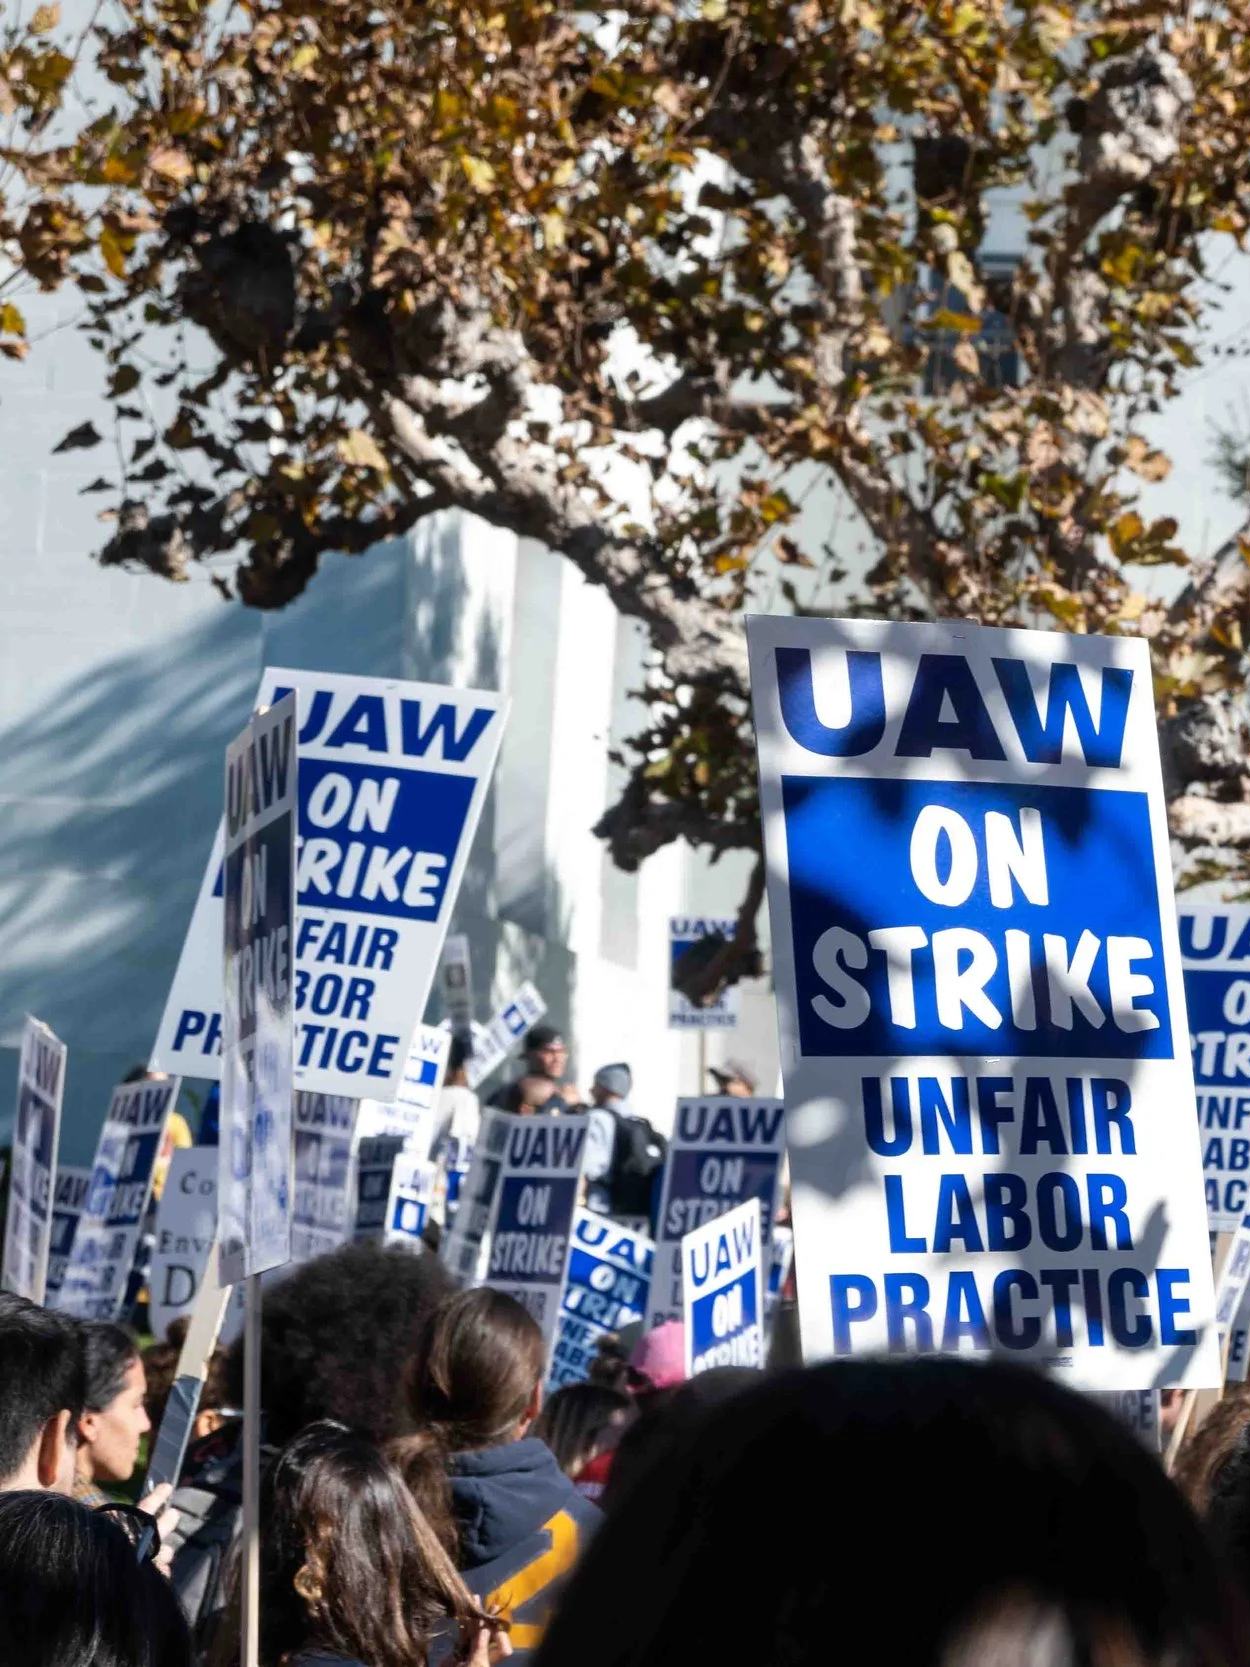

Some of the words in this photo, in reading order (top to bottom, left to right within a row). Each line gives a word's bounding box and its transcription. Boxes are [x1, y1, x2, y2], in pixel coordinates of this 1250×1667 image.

[775, 647, 1135, 769] UAW
[306, 772, 400, 833] ON
[298, 836, 447, 908] RIKE
[909, 804, 1049, 909] ON
[297, 918, 400, 971] FAIR
[810, 926, 1160, 1034] STRIKE
[508, 1124, 587, 1170] UAW
[678, 1105, 785, 1145] UAW
[861, 1076, 1137, 1157] UNFAIR
[517, 1183, 551, 1227] ON
[701, 1156, 745, 1196] ON
[883, 1171, 1135, 1254] LABOR
[490, 1232, 566, 1276] STRIKE
[690, 1214, 756, 1288] UAW
[589, 1263, 641, 1304] ON
[711, 1283, 743, 1338] ON
[828, 1267, 1197, 1355] PRACTICE
